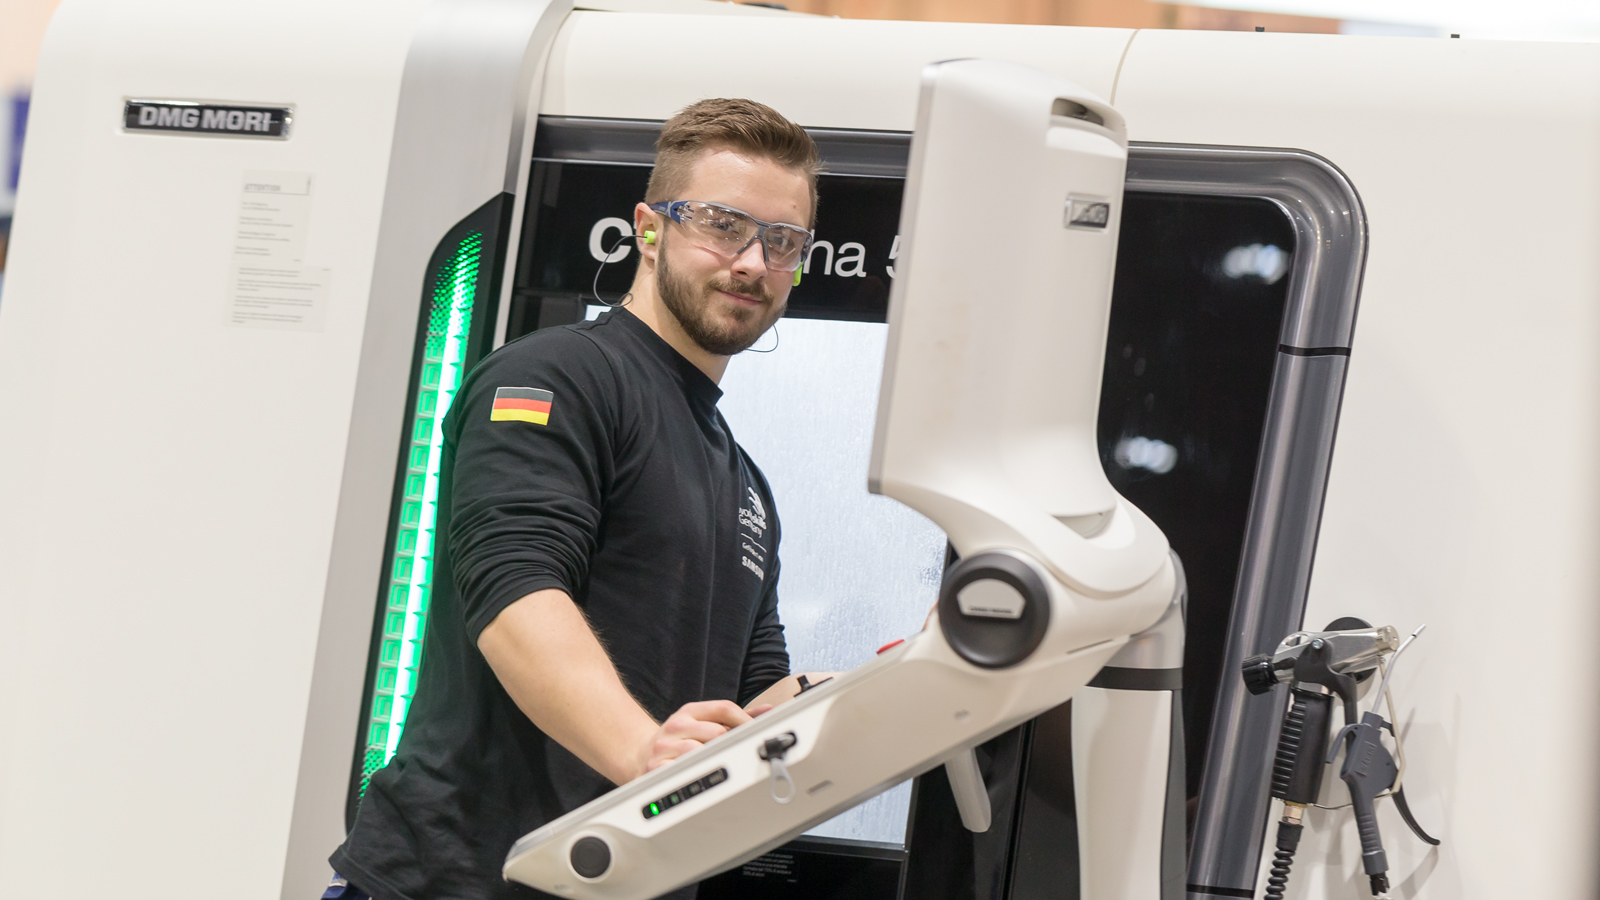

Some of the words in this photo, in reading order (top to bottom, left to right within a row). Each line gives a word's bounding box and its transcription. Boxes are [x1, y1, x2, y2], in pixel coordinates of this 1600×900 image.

[139, 106, 200, 128] DMG
[201, 109, 272, 132] MORI
[589, 216, 637, 263] C
[802, 228, 867, 278] ha
